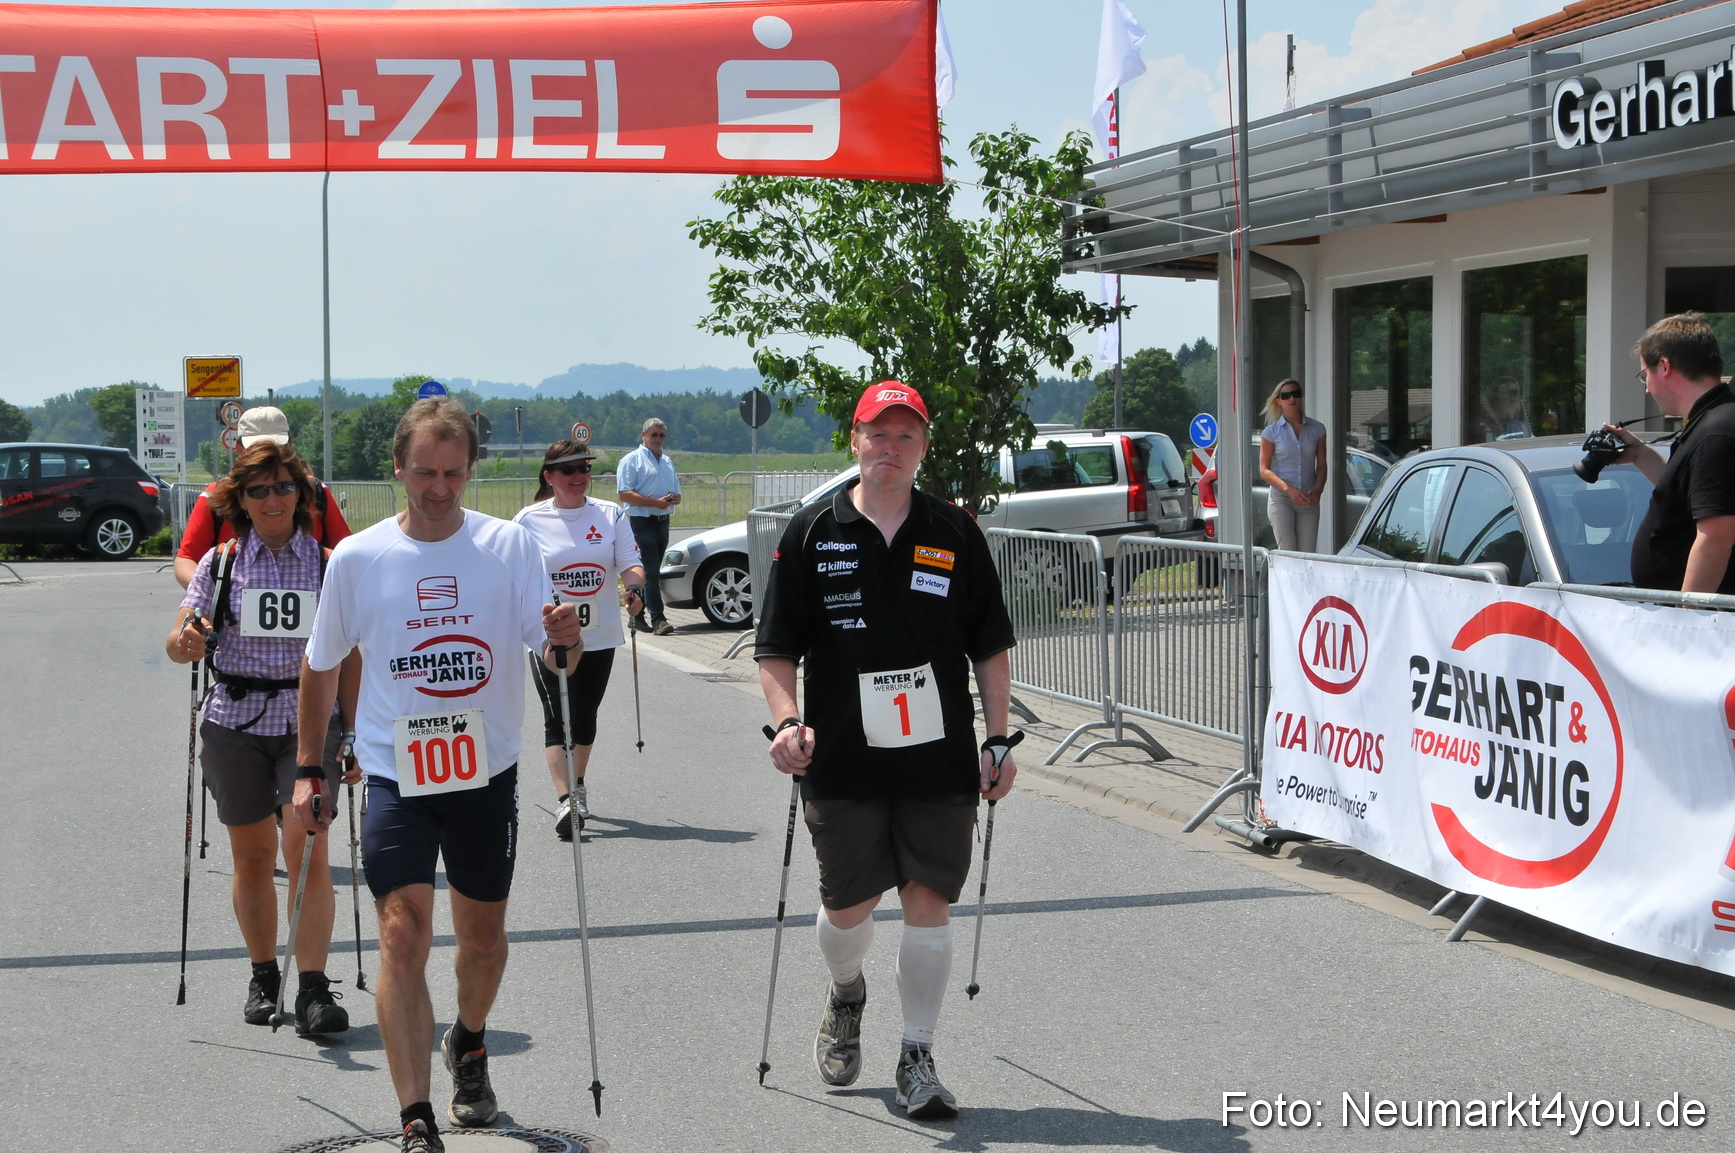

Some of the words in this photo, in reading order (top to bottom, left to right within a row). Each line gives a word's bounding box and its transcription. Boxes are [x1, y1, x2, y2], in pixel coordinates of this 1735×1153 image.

[576, 428, 588, 439] 60
[815, 541, 858, 552] Cellagon
[828, 560, 859, 571] killtec
[550, 570, 596, 581] ERHART
[924, 579, 946, 590] victory
[823, 591, 862, 603] AMADEUS
[258, 591, 301, 631] 69
[405, 614, 474, 630] SEAT
[1312, 619, 1357, 674] KIA
[389, 650, 476, 674] GERHART
[476, 652, 484, 662] &
[873, 672, 912, 686] MEYER
[873, 681, 913, 692] WERBUNG
[1409, 654, 1565, 749] GERHART
[1567, 701, 1588, 744] &
[892, 692, 912, 737] 1
[407, 716, 449, 730] MEYER
[407, 726, 451, 737] WERBUNG
[407, 733, 478, 786] 100
[1284, 774, 1328, 804] Power
[1473, 740, 1590, 827] JÄNIG
